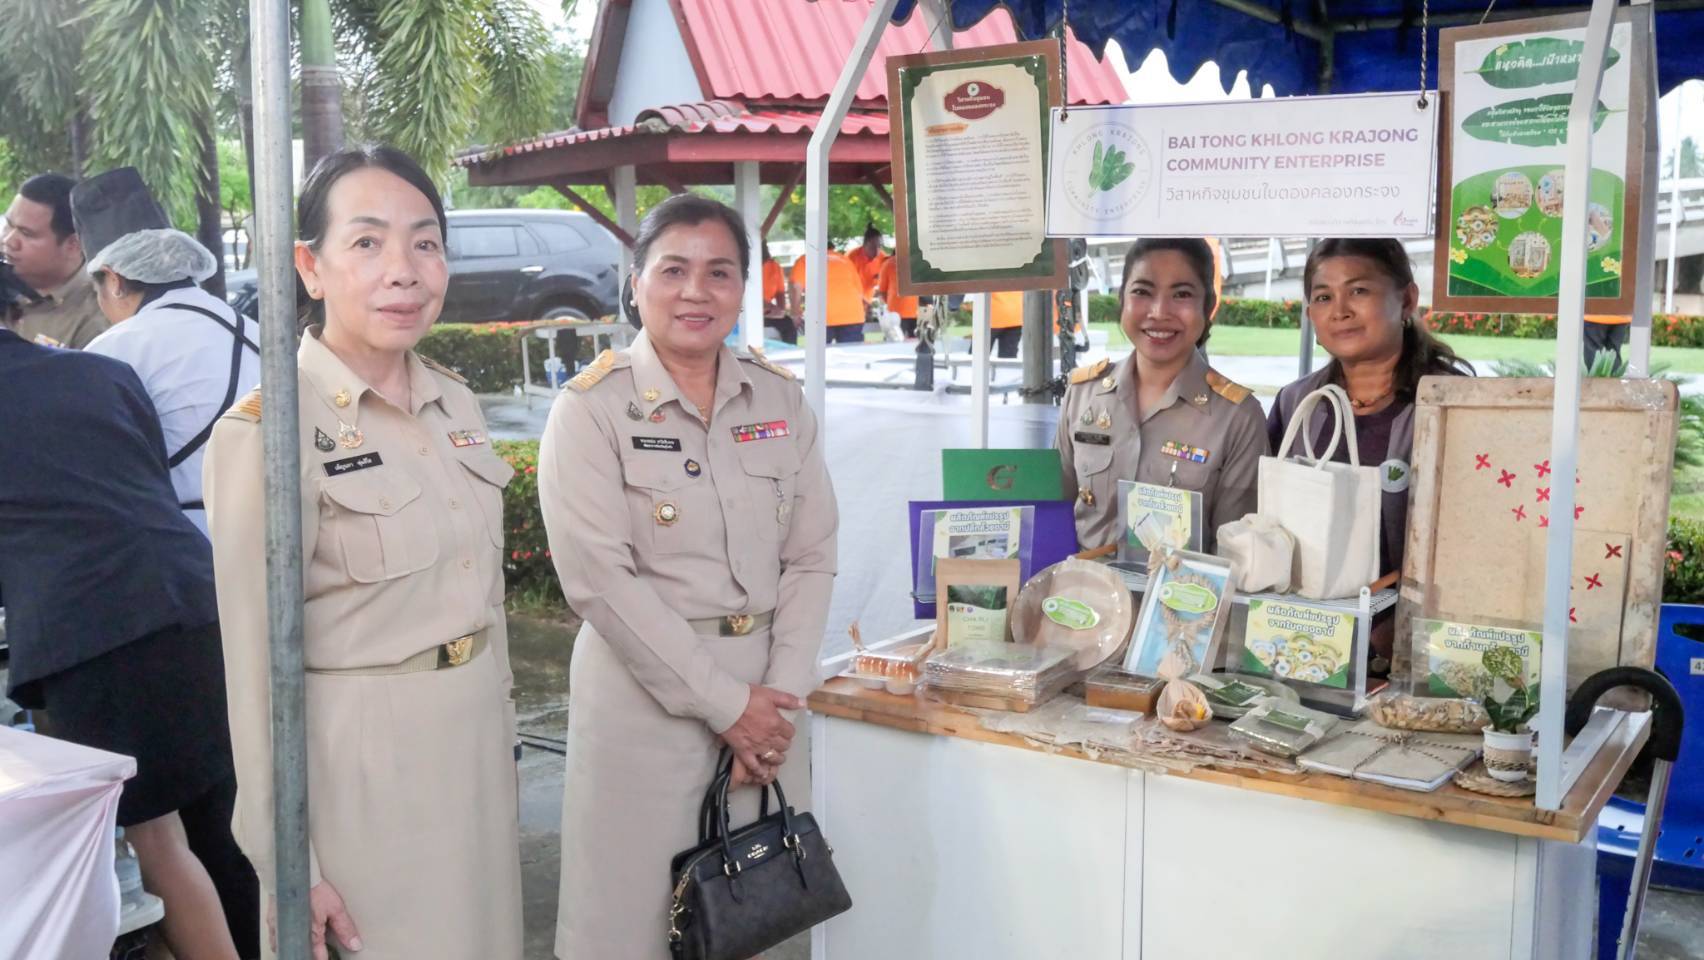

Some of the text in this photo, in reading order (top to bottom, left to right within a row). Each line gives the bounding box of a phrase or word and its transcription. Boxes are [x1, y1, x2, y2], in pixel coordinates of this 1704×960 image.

[1168, 128, 1418, 149] BAI TONG KHLONG KRAJONG
[1166, 153, 1385, 172] COMMUNITY ENTERPRISE
[1166, 182, 1401, 204] วิสาหกิจชุมชนใบตองคลองกระจง
[1267, 605, 1340, 626] ผลิตภัณฑ์แปรรูป
[1268, 618, 1335, 637] จากใบตองตานี
